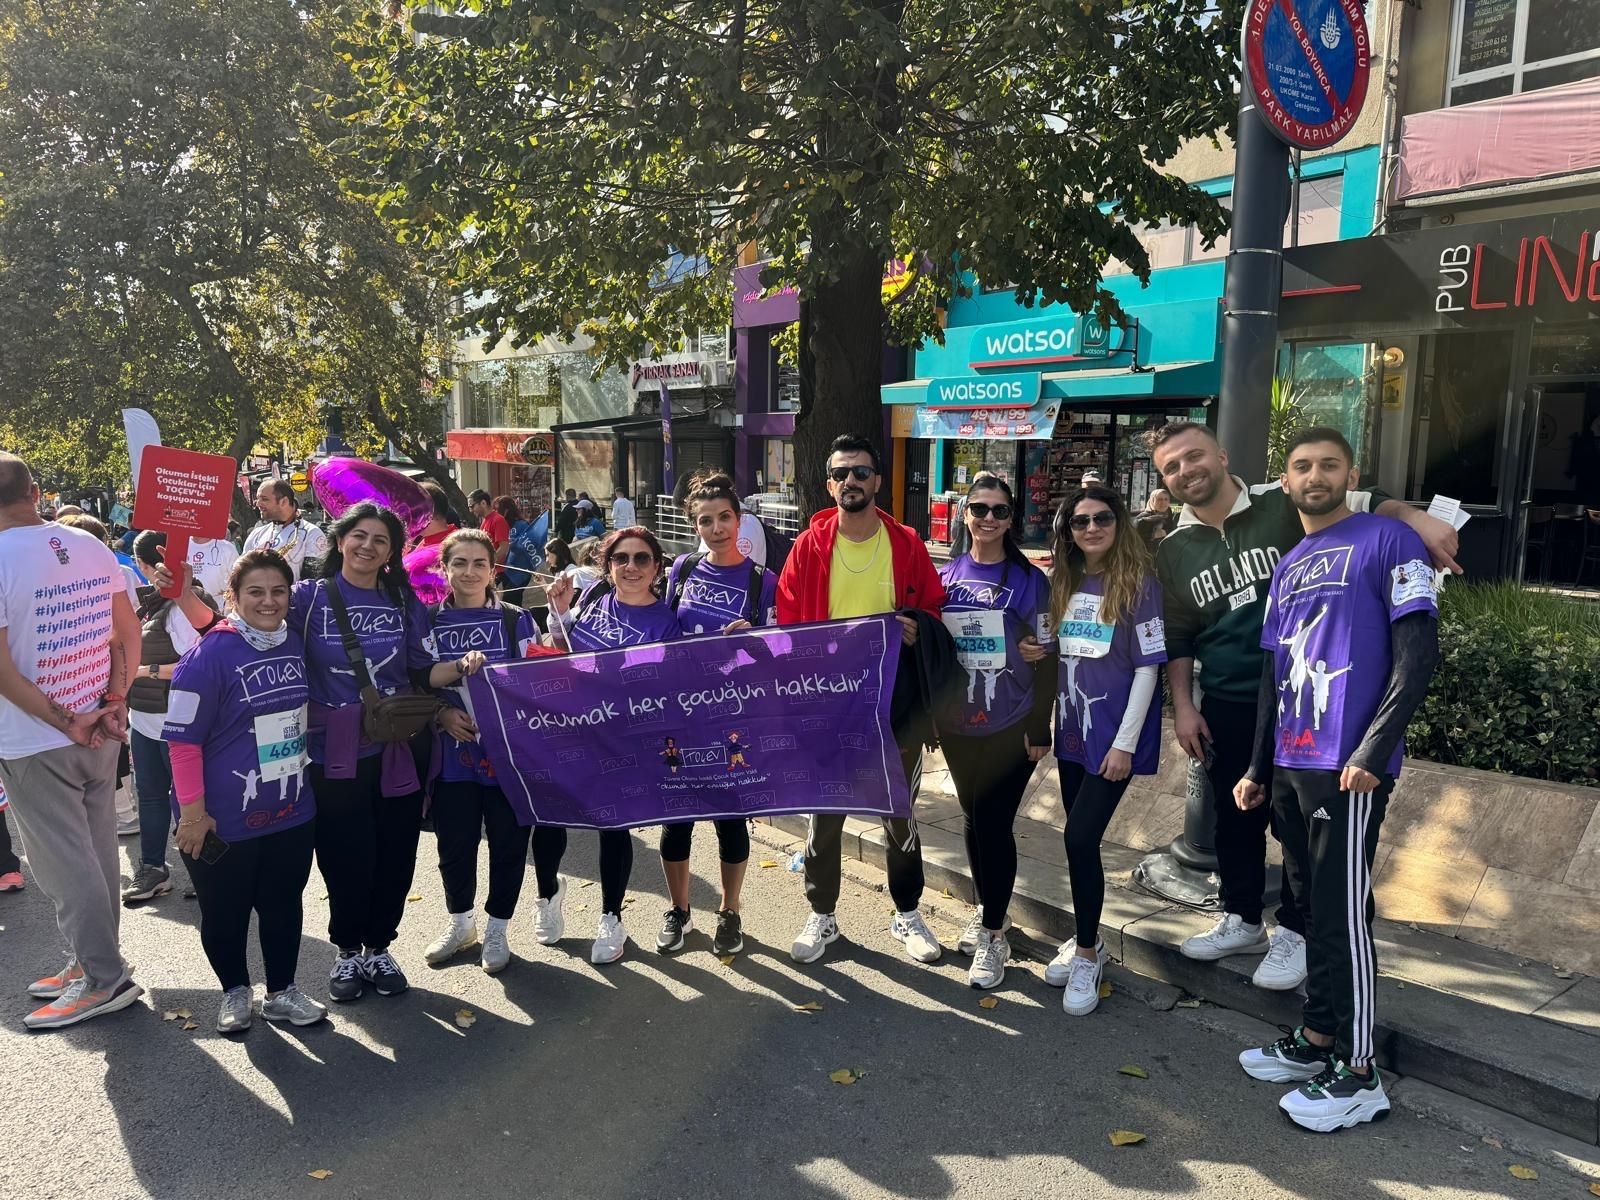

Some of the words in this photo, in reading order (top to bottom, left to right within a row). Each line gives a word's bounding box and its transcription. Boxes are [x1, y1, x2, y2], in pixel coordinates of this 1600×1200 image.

[1290, 11, 1302, 38] YOL
[1301, 39, 1331, 95] BOYUNCA
[1356, 24, 1366, 67] YOLU
[1261, 88, 1292, 131] PARK
[1295, 106, 1353, 141] YAPILMAZ
[1435, 244, 1471, 312] PUB
[939, 381, 1022, 401] watsons
[155, 467, 190, 479] Okuma
[191, 470, 219, 484] İstekli
[157, 475, 197, 489] Çocuklar
[198, 482, 216, 491] için
[157, 492, 211, 506] koşuyorum!
[166, 485, 205, 498] TOÇEV'le
[34, 576, 110, 599] #iyileştiriyoruz
[1190, 546, 1281, 608] ORLANDO
[35, 592, 110, 617] #iyileştiriyoruz
[36, 609, 111, 634] #iyileştiriyoruz
[1063, 622, 1102, 639] 42346
[37, 624, 111, 651] #iyileştiriyoruz
[955, 638, 996, 652] 42348
[628, 697, 668, 716] her
[677, 680, 766, 716] çocuğun
